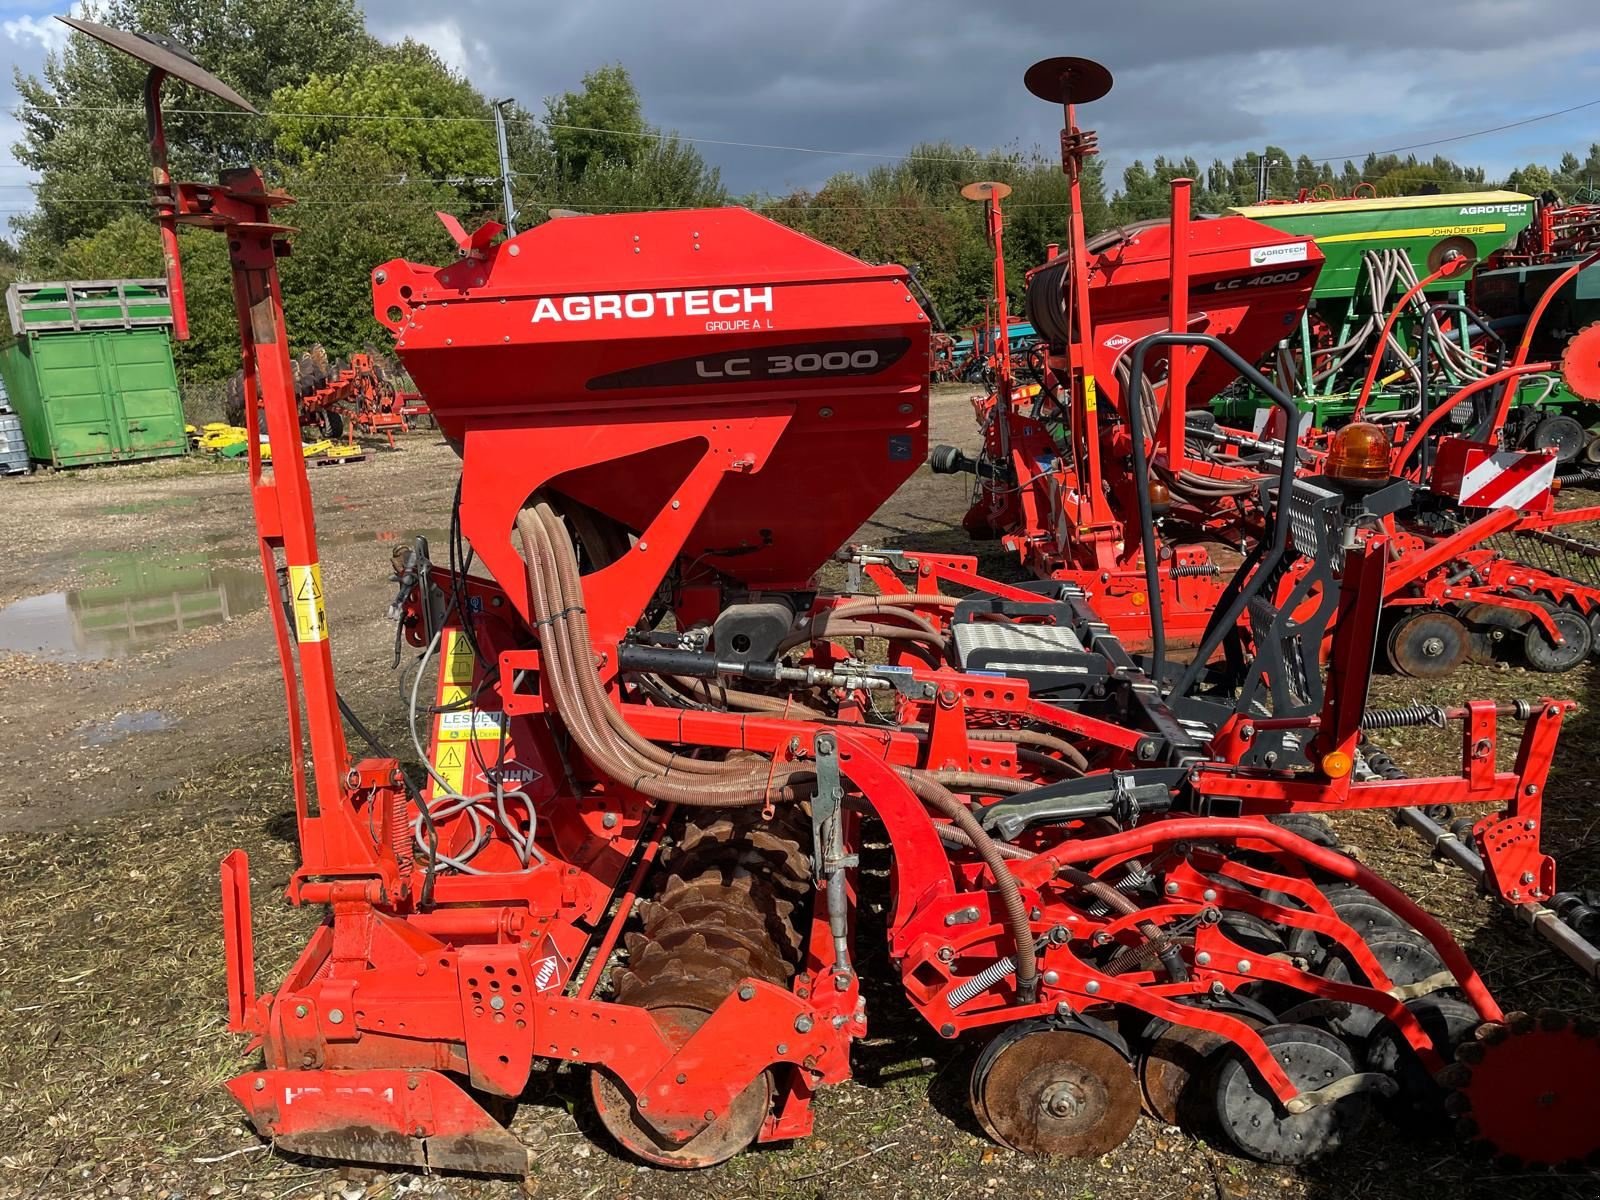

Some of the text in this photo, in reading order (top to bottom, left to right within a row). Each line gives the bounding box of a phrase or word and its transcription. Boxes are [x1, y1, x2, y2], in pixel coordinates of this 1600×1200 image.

[1459, 204, 1527, 215] AGROTECH
[1454, 226, 1484, 234] DEERE
[1261, 246, 1306, 257] AGROTECH
[1214, 272, 1300, 291] LC 4000
[531, 286, 774, 323] AGROTECH
[705, 320, 750, 332] GROUPE
[695, 350, 879, 377] LC 3000
[535, 958, 557, 990] KUHN
